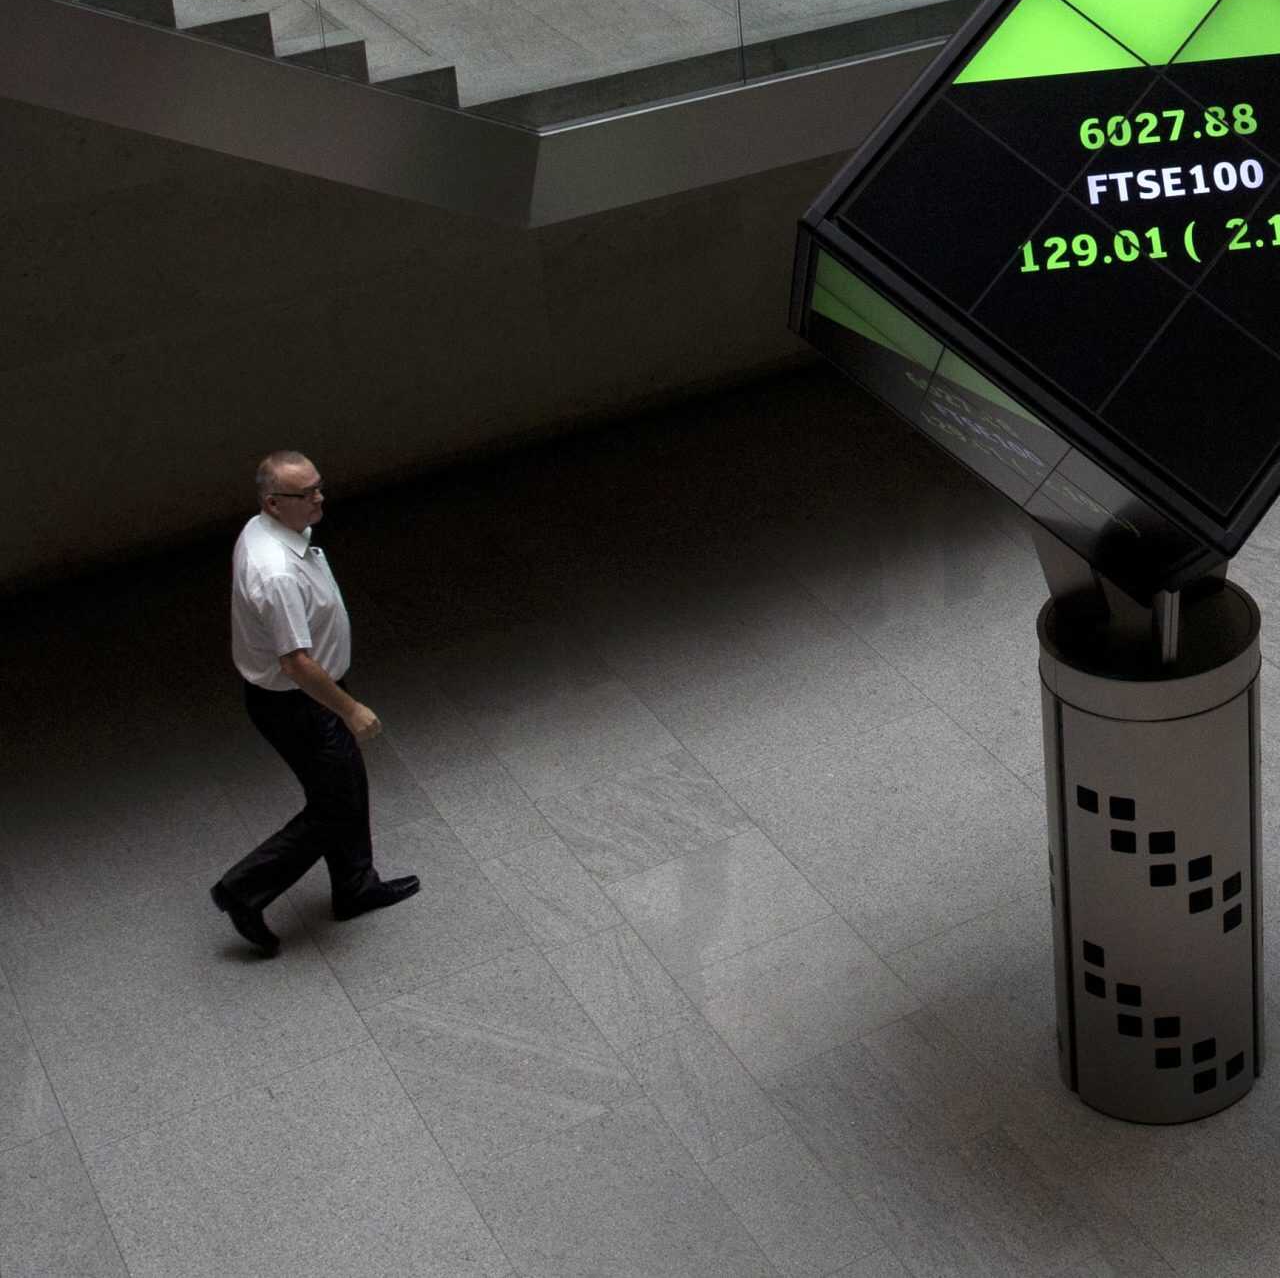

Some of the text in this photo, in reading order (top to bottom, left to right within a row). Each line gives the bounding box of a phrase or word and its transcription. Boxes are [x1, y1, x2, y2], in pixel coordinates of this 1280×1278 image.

[1079, 103, 1258, 151] 6027.88
[1086, 159, 1264, 205] FTSE100
[1019, 226, 1168, 274] 129.01
